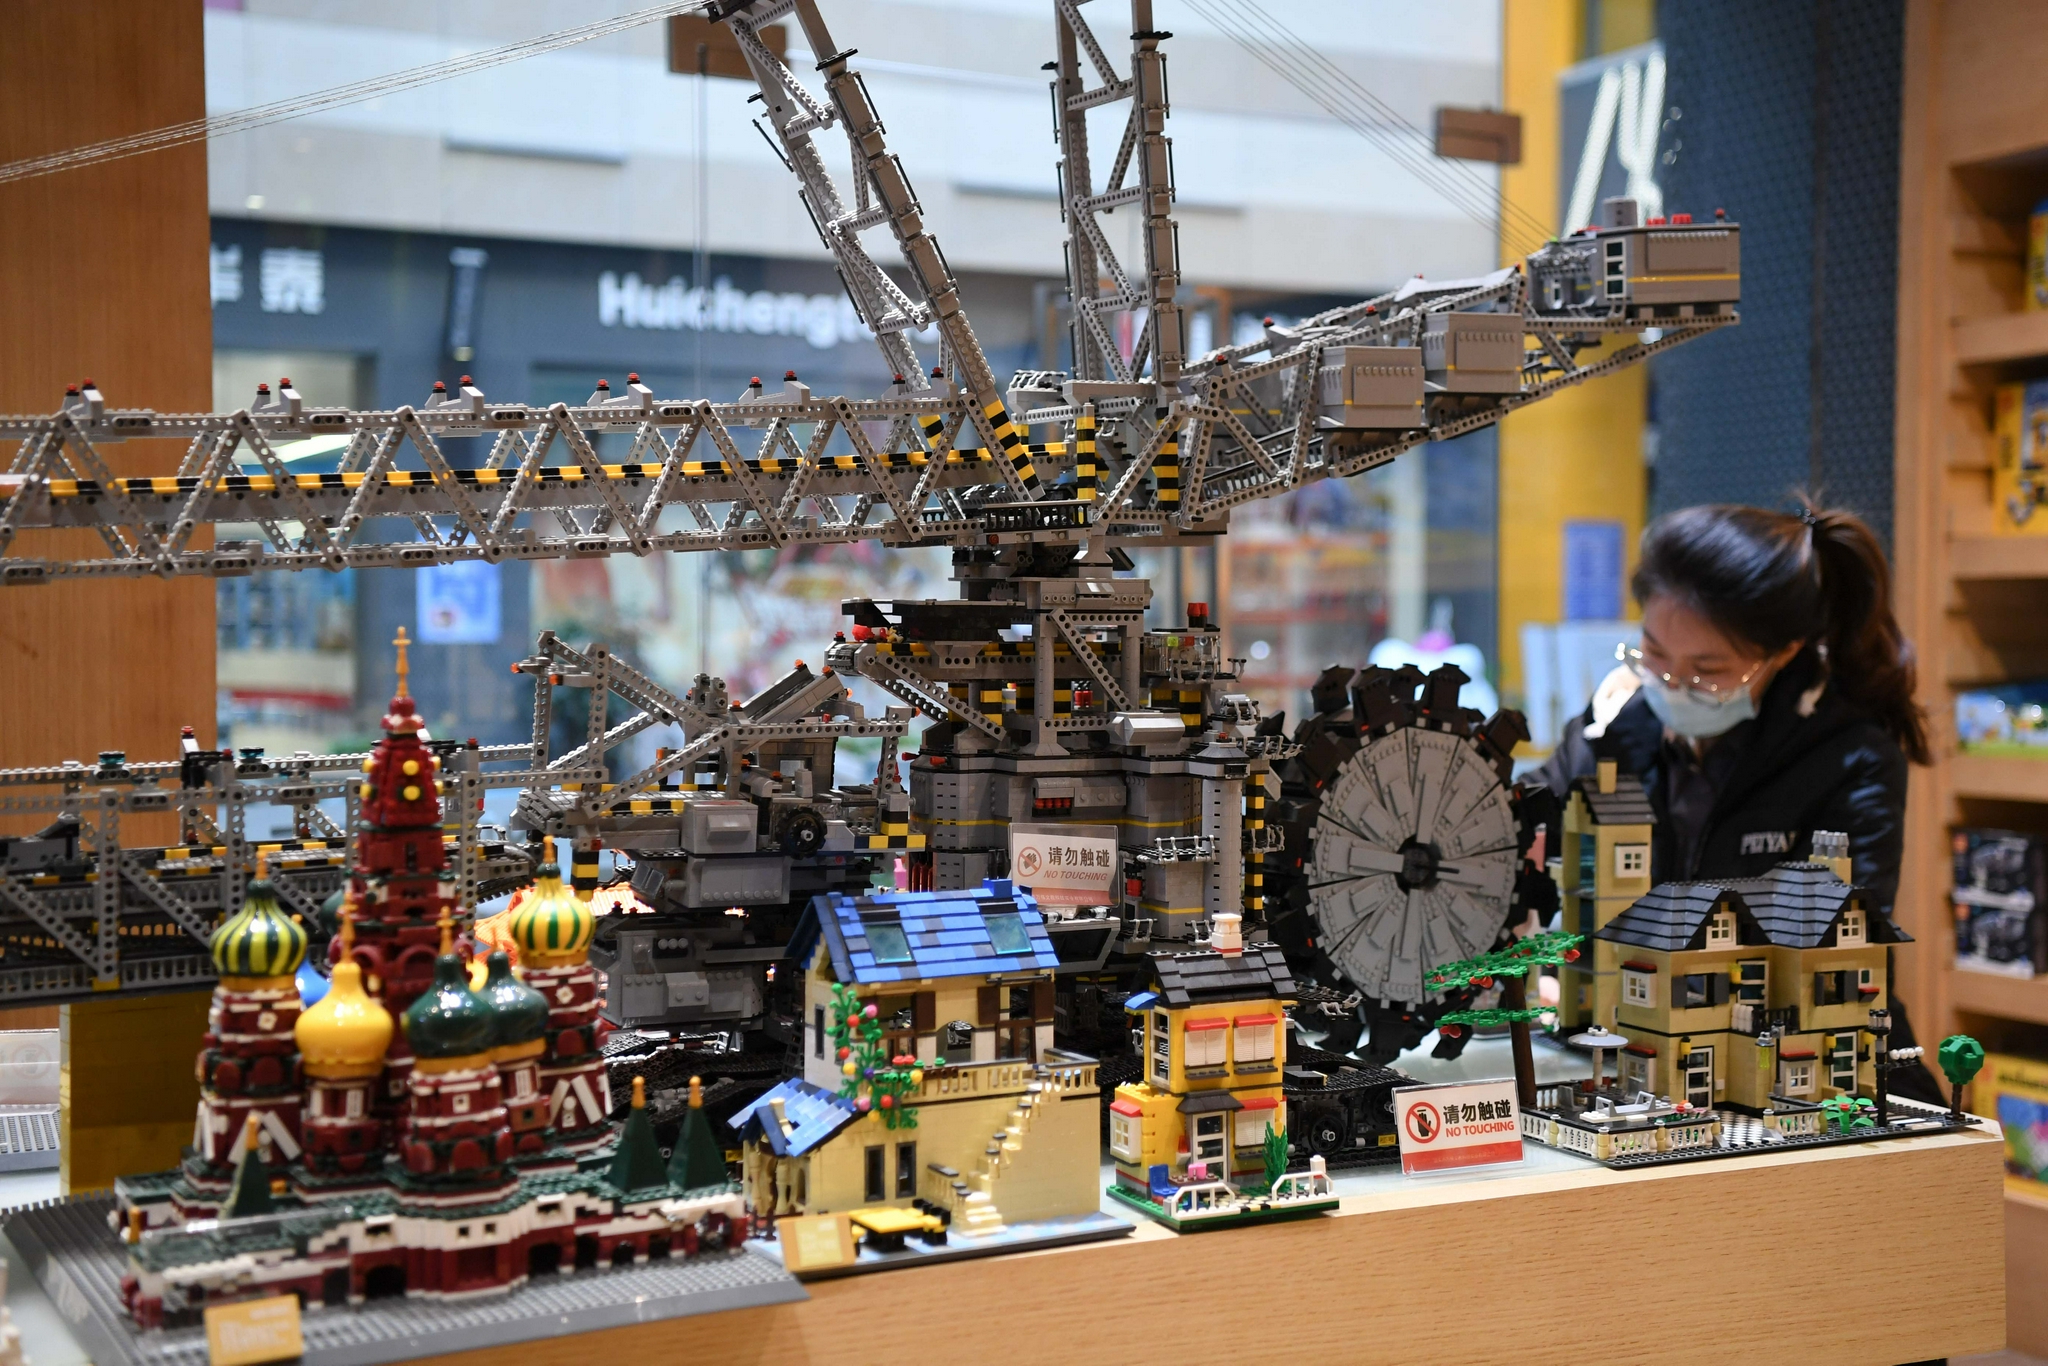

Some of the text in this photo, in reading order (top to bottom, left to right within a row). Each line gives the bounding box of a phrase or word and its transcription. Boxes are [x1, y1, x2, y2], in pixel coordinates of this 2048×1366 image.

[1048, 846, 1110, 867] 请勿触碰
[1044, 870, 1108, 881] NO TOUCHING
[1443, 1099, 1511, 1124] 请勿触碰
[1446, 1121, 1514, 1137] NO TOUCHING
